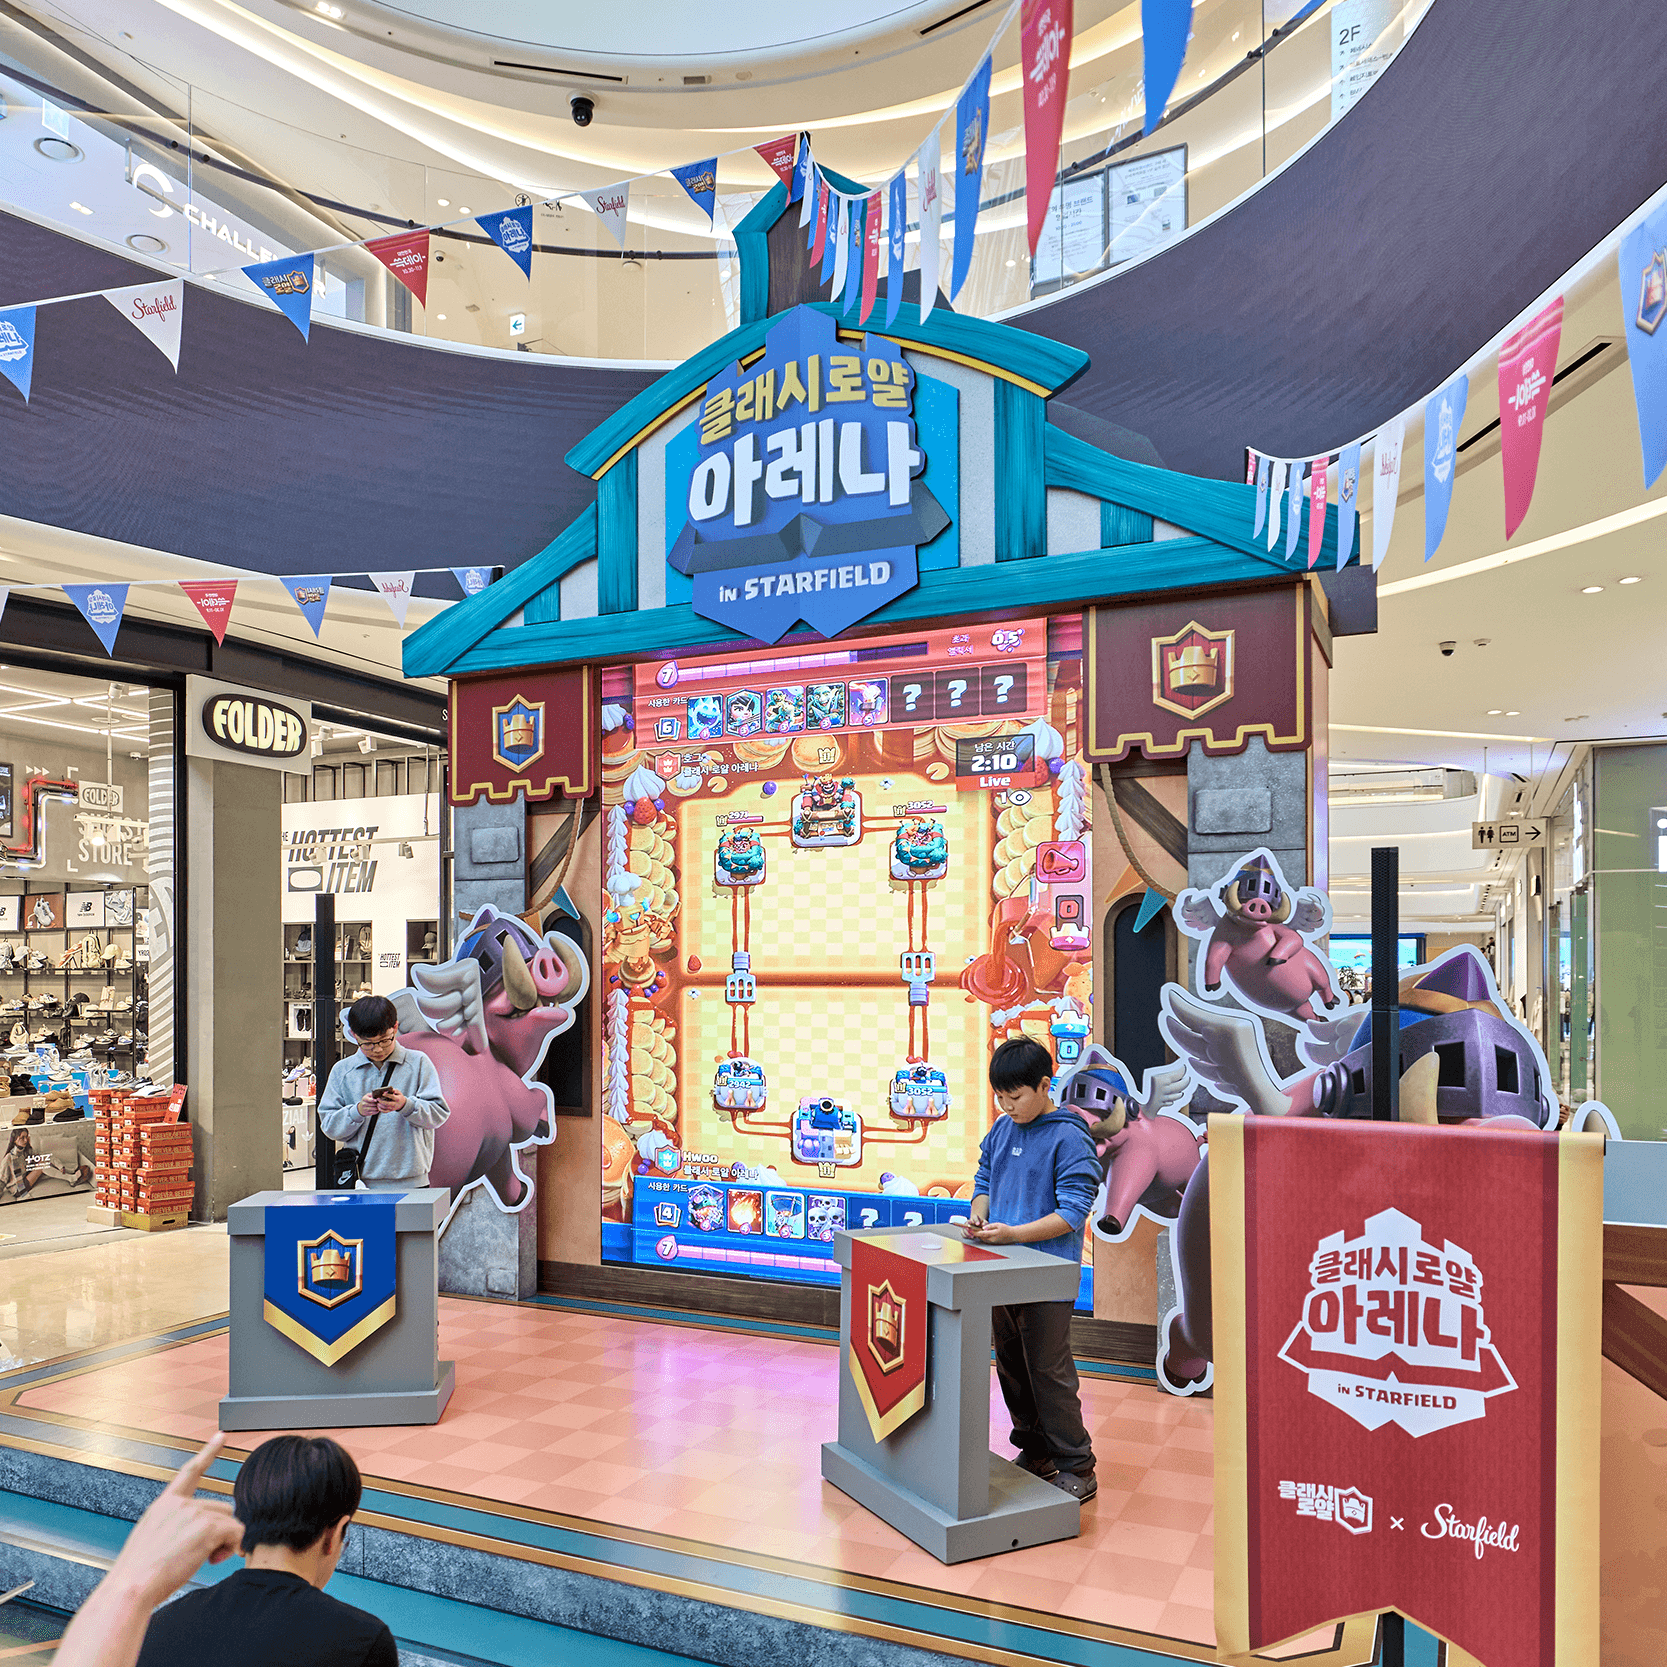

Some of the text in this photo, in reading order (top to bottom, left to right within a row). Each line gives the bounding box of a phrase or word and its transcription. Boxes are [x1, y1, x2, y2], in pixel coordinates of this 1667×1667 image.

[1339, 24, 1361, 46] 2F
[596, 195, 625, 217] Starfield
[131, 295, 178, 324] Starfield
[699, 353, 910, 445] 클래시로얄
[688, 418, 921, 527] 아레나
[745, 561, 891, 600] STARFIELD
[991, 630, 1020, 646] 0.5
[661, 669, 674, 683] 7
[648, 695, 688, 708] 사용한 카드
[213, 698, 303, 753] FOLDER
[663, 722, 672, 734] 6
[974, 740, 1016, 753] 남은 시간
[712, 763, 730, 775] 로얄
[731, 761, 759, 774] 아레나
[971, 753, 1018, 773] 2:10
[980, 776, 1010, 789] Live
[907, 800, 934, 811] 3052
[79, 838, 133, 866] STORE
[325, 860, 379, 894] ITEM
[379, 953, 401, 961] HOTTEST
[388, 960, 401, 968] ITEM
[728, 1079, 752, 1090] 2942
[907, 1087, 934, 1097] 3052
[25, 1153, 52, 1164] HOTZ
[648, 1182, 688, 1193] 사용한 카드
[662, 1207, 673, 1219] 4
[662, 1242, 674, 1255] 7
[1315, 1246, 1477, 1300] 클래시로얄
[1308, 1284, 1485, 1362] 아레나
[1355, 1385, 1457, 1410] STARFIELD
[1277, 1480, 1334, 1501] 클래시
[1296, 1498, 1336, 1521] 로얄
[1420, 1502, 1520, 1560] Starfield
